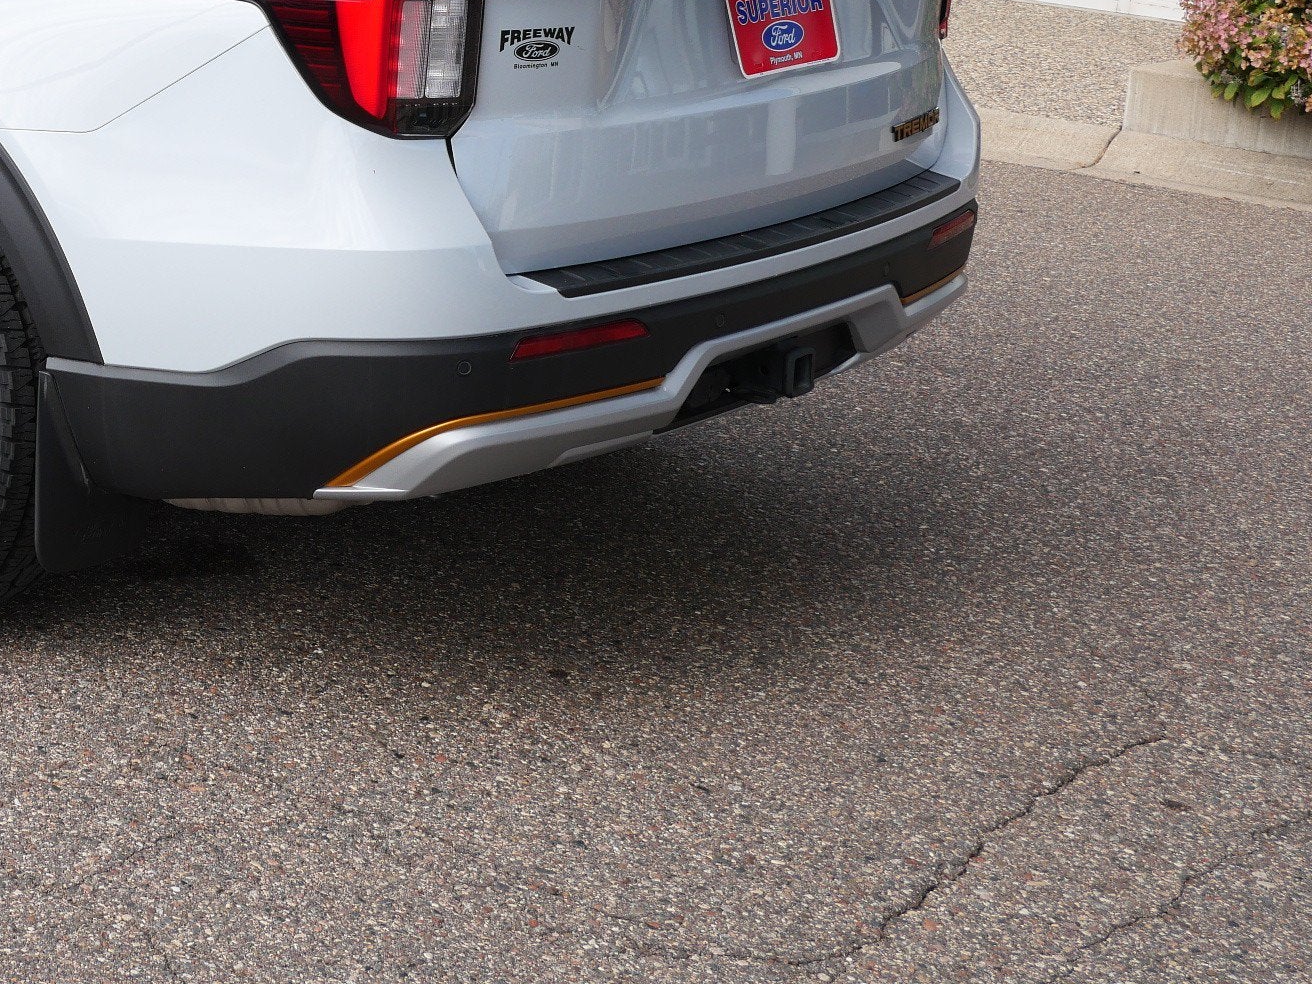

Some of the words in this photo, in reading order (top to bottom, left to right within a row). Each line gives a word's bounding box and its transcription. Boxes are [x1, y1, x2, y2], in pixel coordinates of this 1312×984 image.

[499, 26, 576, 53] FREEWAY
[770, 25, 796, 47] Ford
[522, 43, 552, 58] Ford
[793, 50, 803, 59] MN
